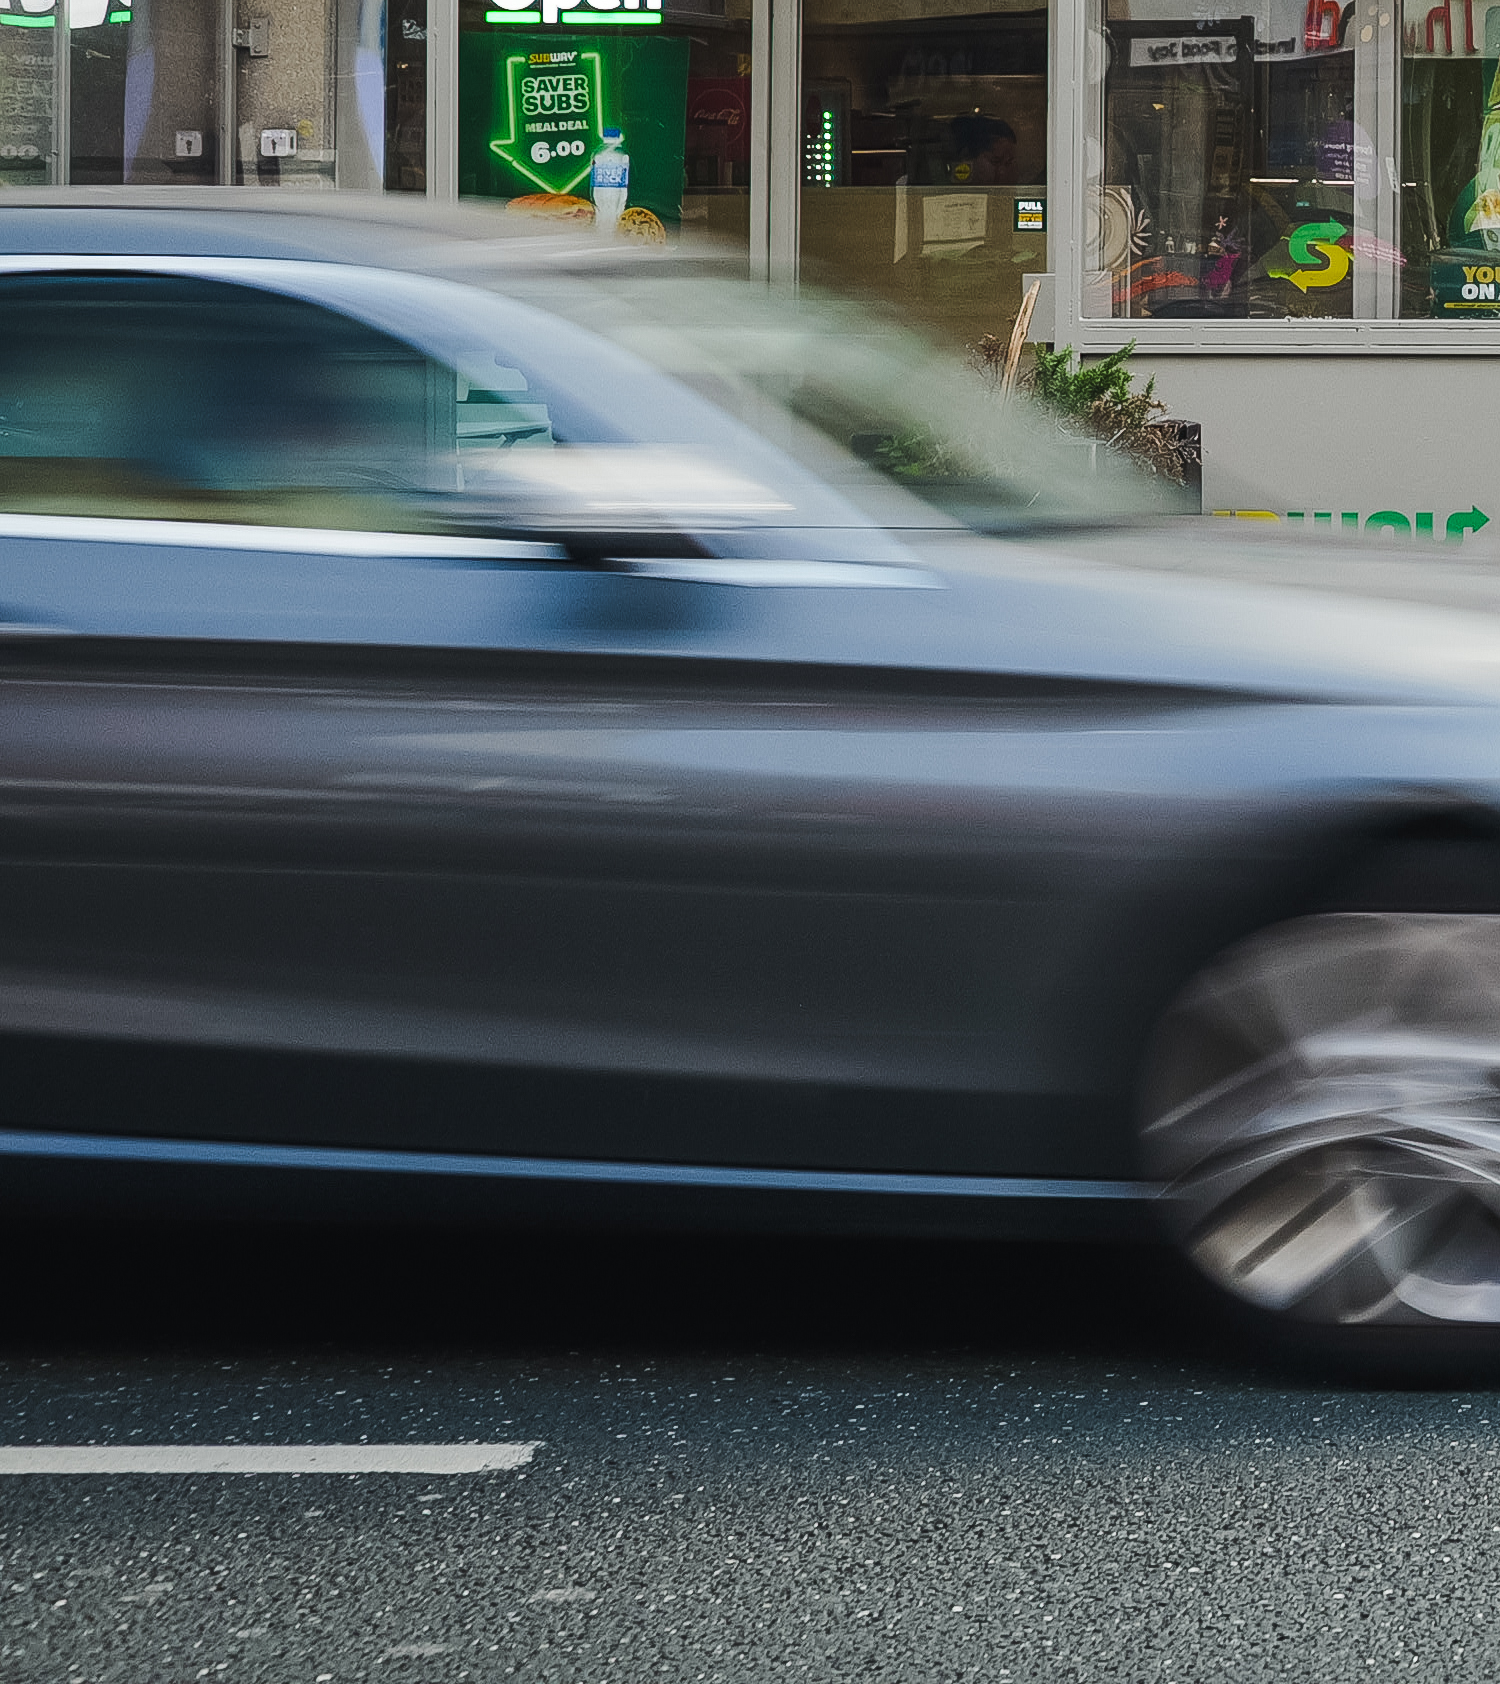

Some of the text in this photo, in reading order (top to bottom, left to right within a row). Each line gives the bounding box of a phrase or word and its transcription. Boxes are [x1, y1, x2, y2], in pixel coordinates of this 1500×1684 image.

[527, 51, 578, 64] SUBWAY
[521, 74, 589, 95] SAVER
[522, 91, 590, 116] SUBS
[525, 119, 590, 133] MEAL DEAL
[530, 139, 586, 164] 6.00
[1018, 201, 1044, 211] PULL
